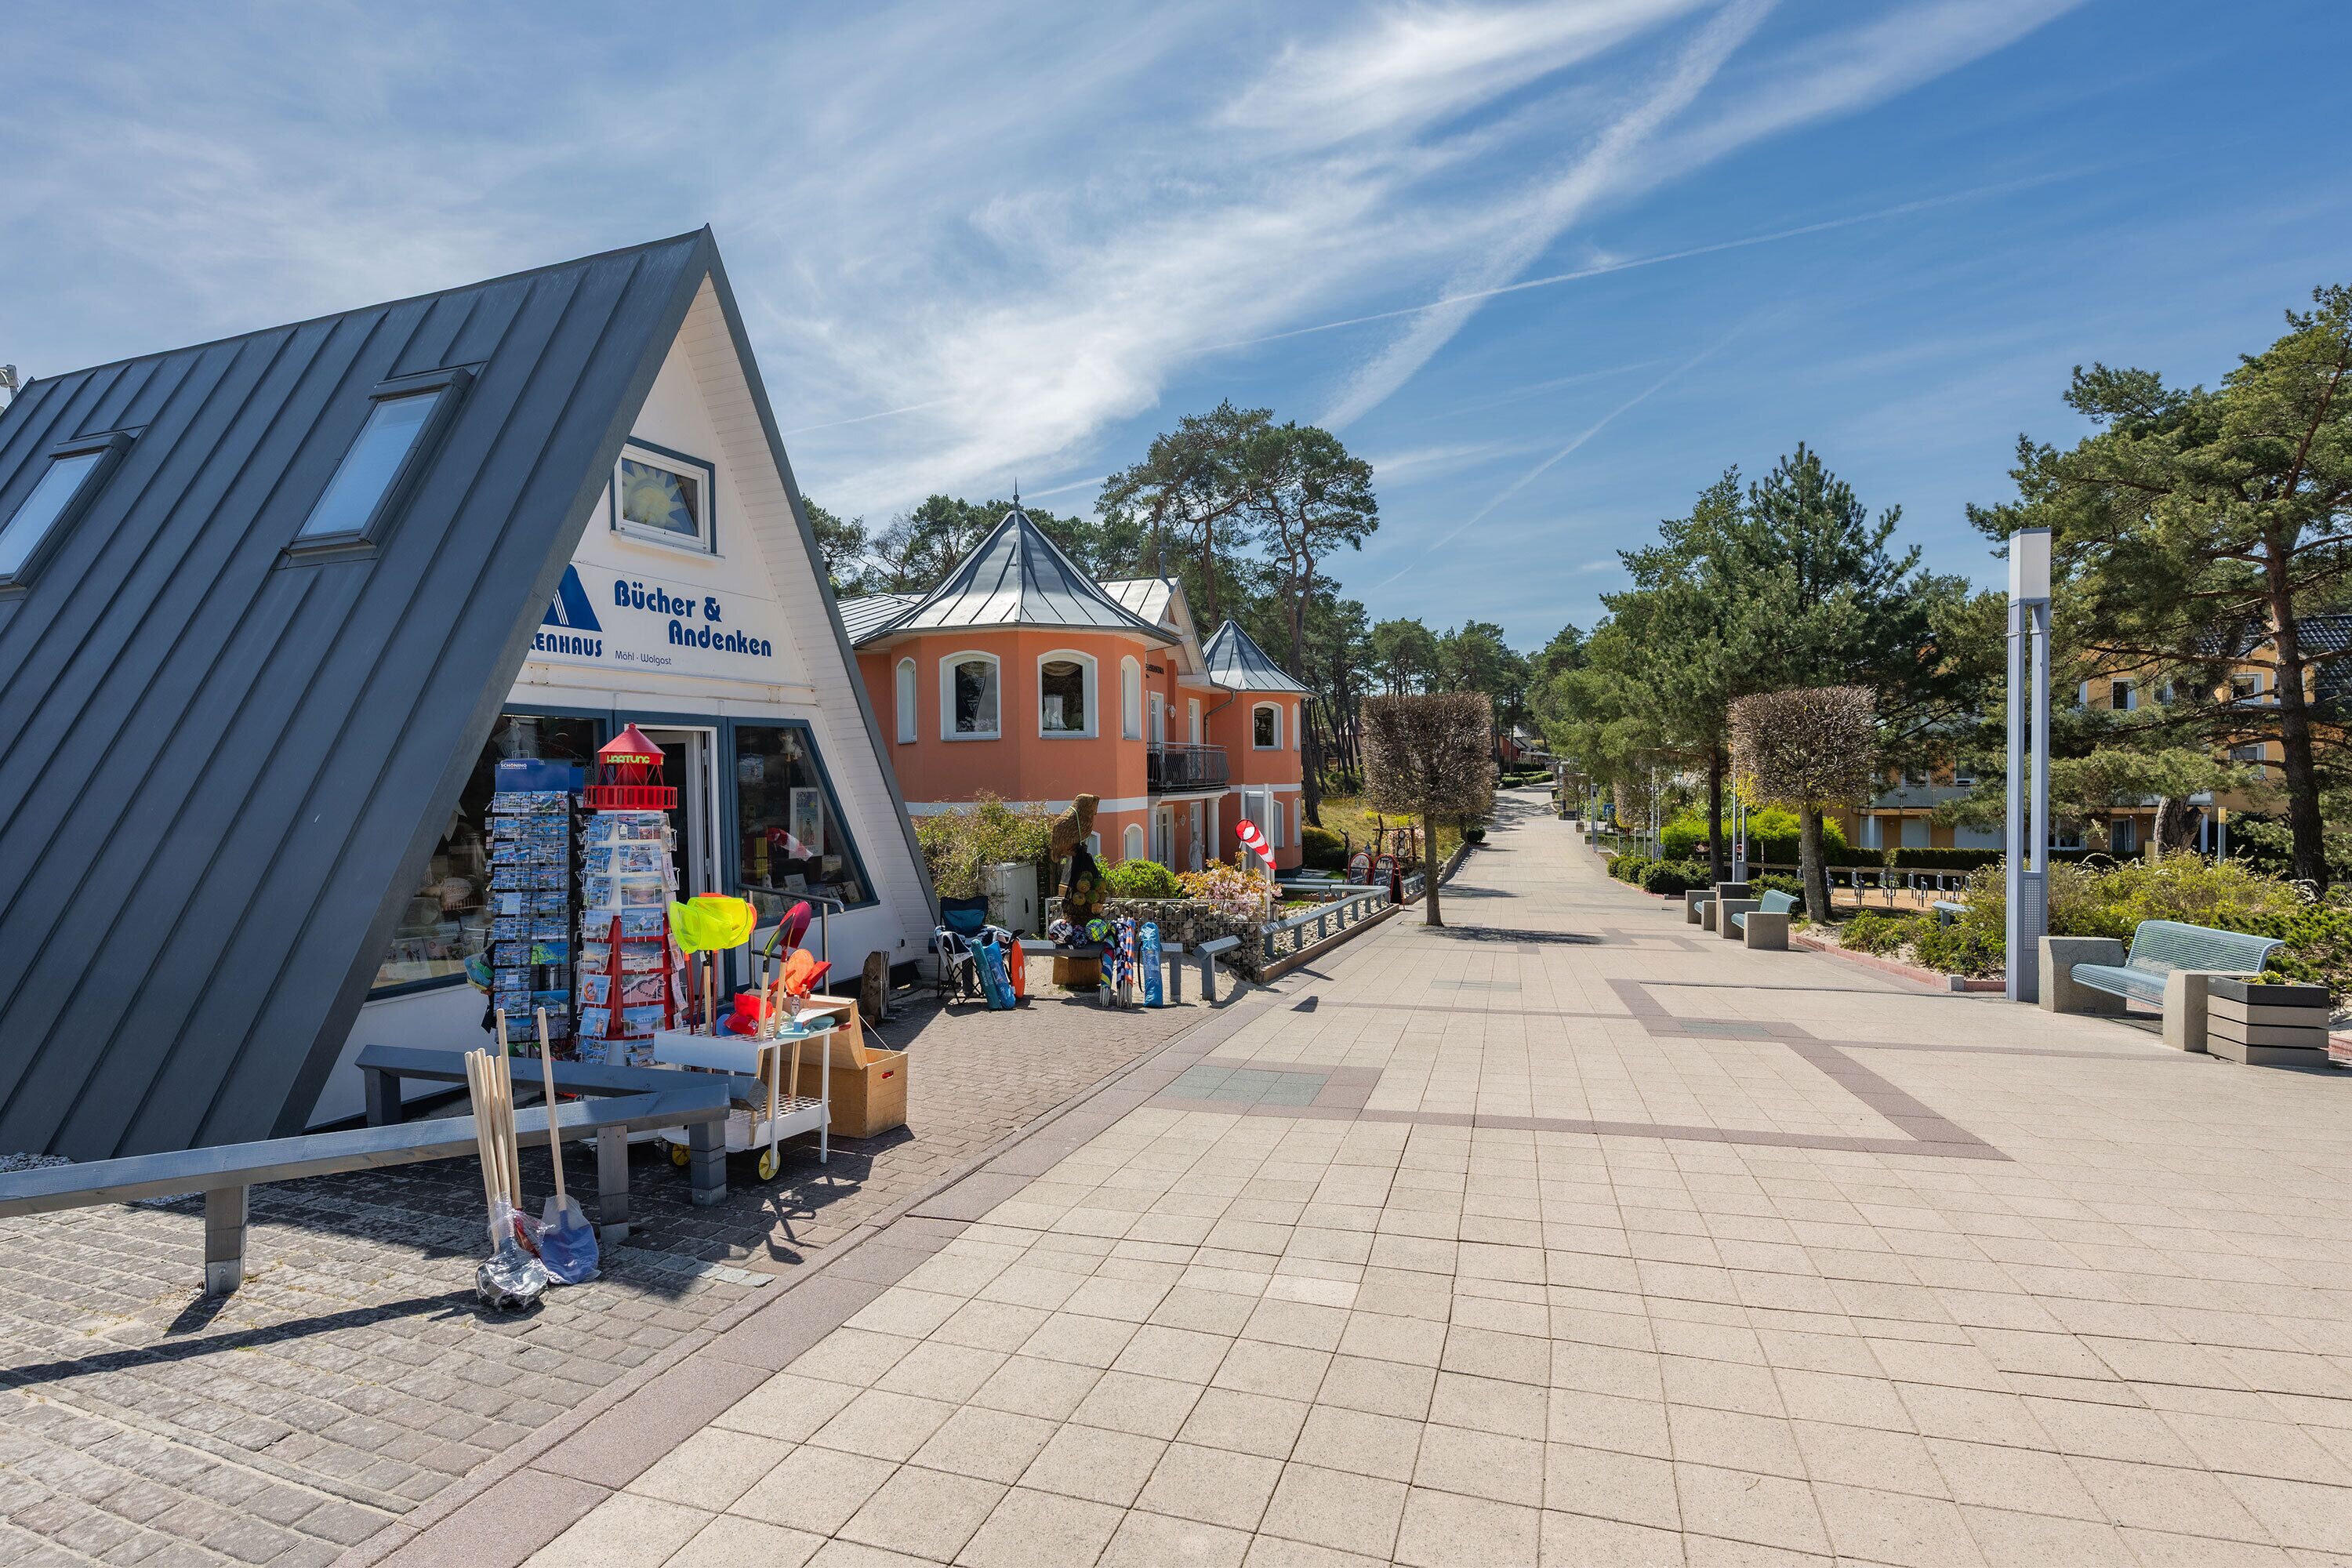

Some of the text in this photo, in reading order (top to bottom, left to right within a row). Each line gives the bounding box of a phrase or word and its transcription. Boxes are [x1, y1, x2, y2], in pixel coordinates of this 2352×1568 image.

[614, 579, 722, 622] Bücher &
[531, 632, 602, 657] ENHAUS
[668, 619, 772, 658] Andenken
[615, 650, 672, 666] Möhl Wolgast
[607, 755, 650, 764] HARTUNG
